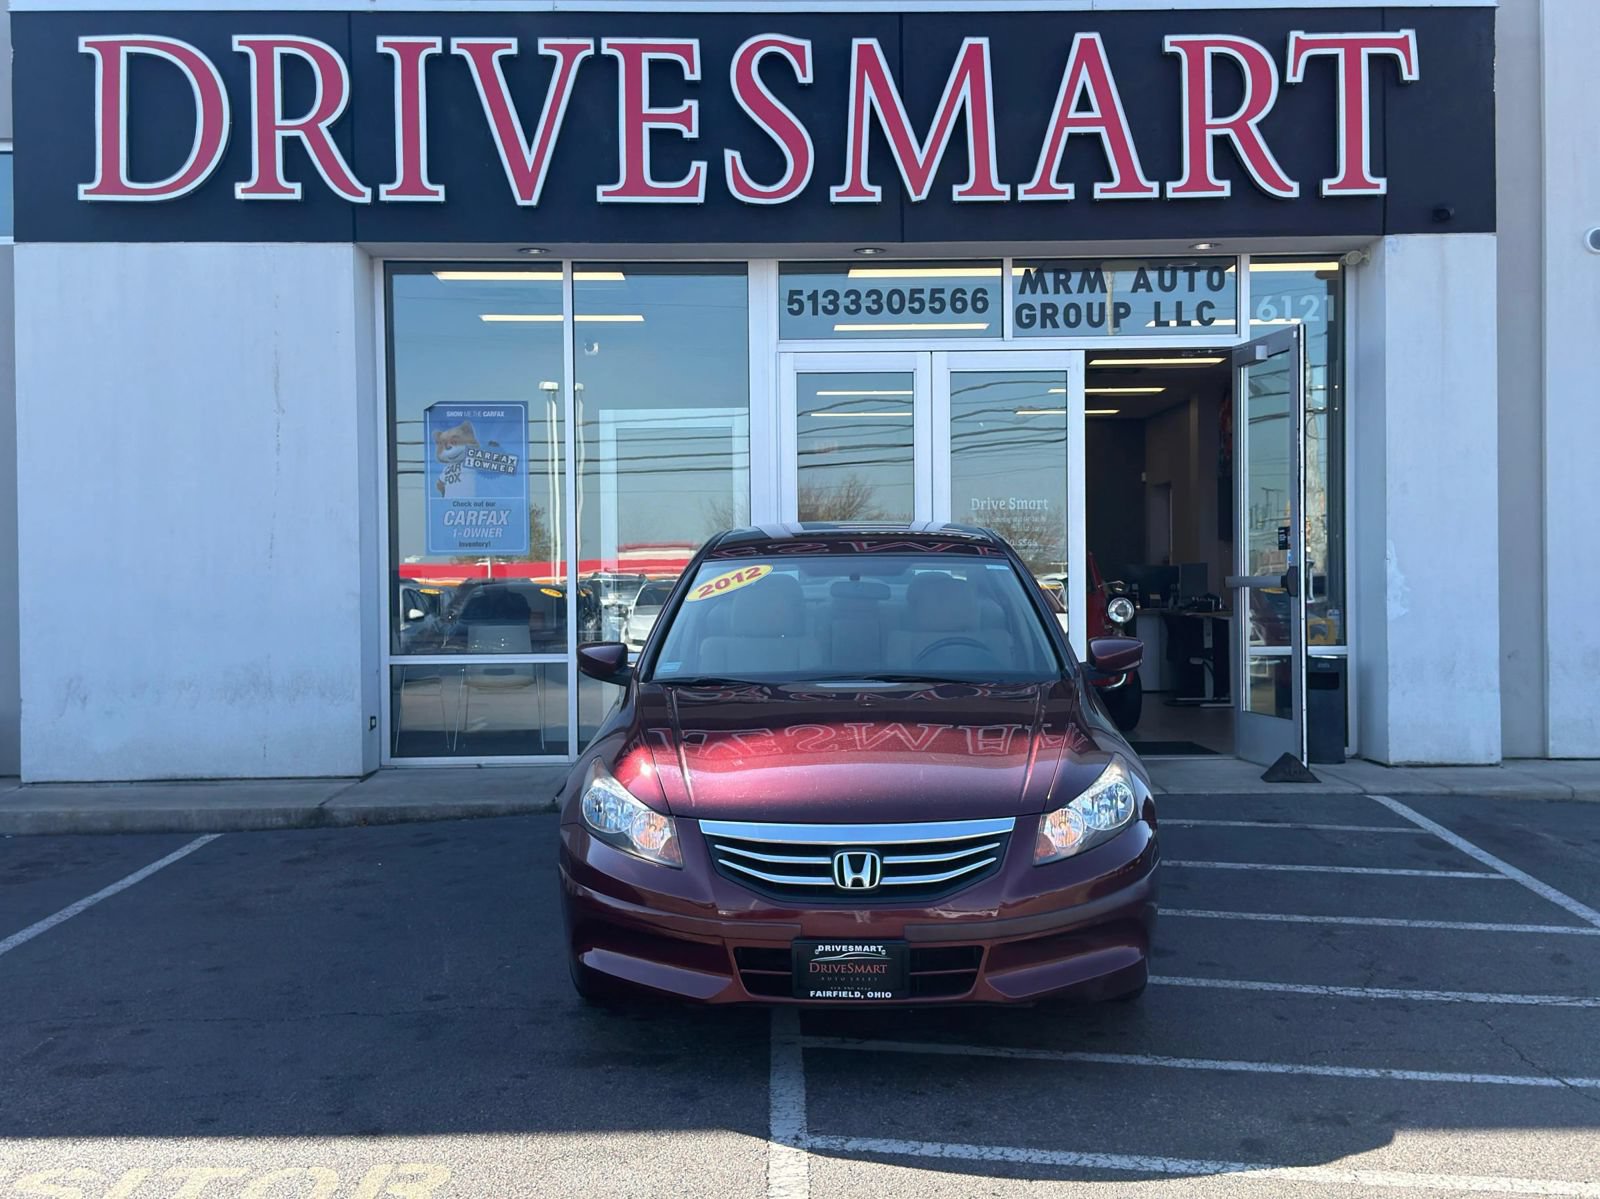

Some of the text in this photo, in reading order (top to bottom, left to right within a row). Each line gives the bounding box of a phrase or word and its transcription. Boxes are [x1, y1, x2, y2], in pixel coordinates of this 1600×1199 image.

[78, 29, 1420, 206] DRIVESMART
[1018, 265, 1226, 295] MRM AUTO
[787, 287, 990, 317] 5133305566
[1256, 294, 1335, 322] 6121
[1015, 300, 1216, 329] GROUP LLC
[467, 449, 518, 465] CARFAX
[474, 460, 515, 473] OWNER
[971, 497, 1049, 510] Drive Smart
[443, 510, 510, 526] CARFAX
[452, 527, 503, 538] 1-OWNER
[698, 567, 762, 599] 2012
[810, 990, 864, 999] FAIRFIELD,
